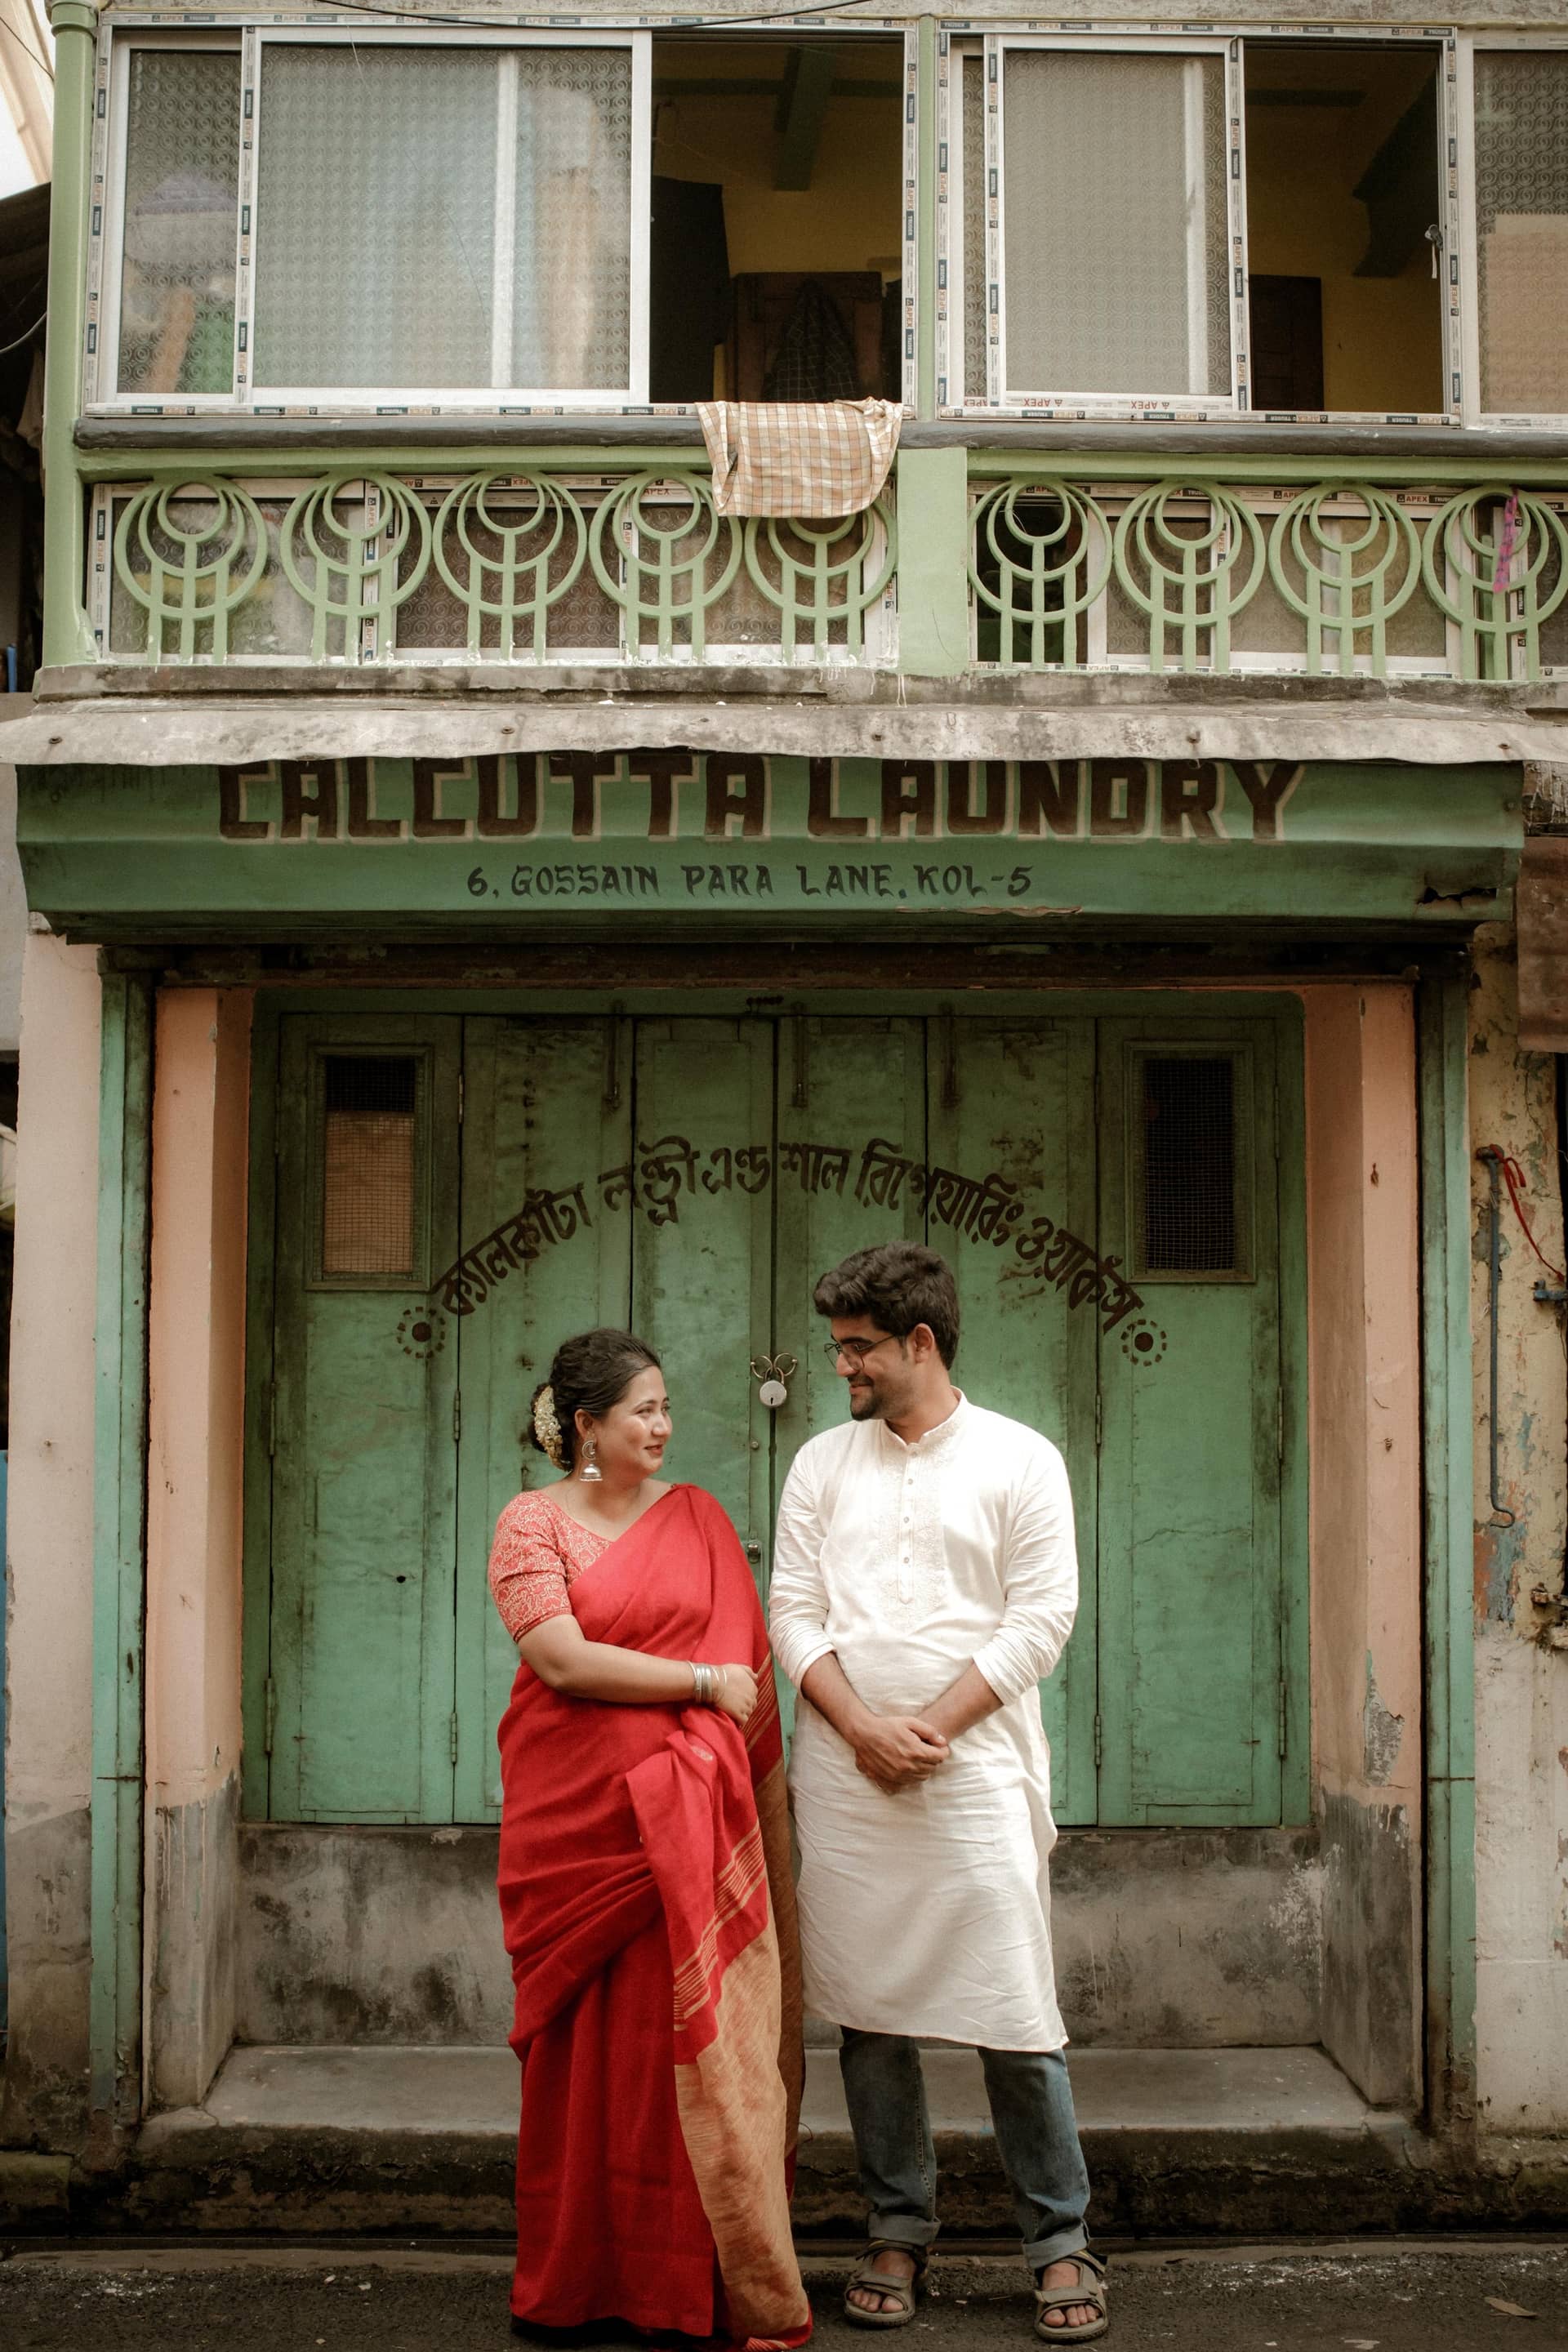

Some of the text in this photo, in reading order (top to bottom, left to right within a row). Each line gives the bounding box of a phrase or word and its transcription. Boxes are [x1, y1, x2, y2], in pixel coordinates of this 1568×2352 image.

[1232, 126, 1240, 148] APEX
[939, 173, 947, 194] APEX
[1448, 169, 1456, 189] APEX
[906, 189, 915, 210] APEX
[1234, 245, 1242, 267] APEX
[1450, 286, 1459, 307] APEX
[906, 306, 914, 327] APEX
[1238, 363, 1246, 385] APEX
[1023, 398, 1051, 407] APEX
[1130, 400, 1158, 409] APEX
[219, 754, 1305, 846] CALCUTTA LAUNDRY
[510, 864, 661, 901] GOSSAIN
[679, 864, 777, 899] PARA
[912, 864, 1034, 898] KOL-5
[777, 1141, 853, 1197] শাল
